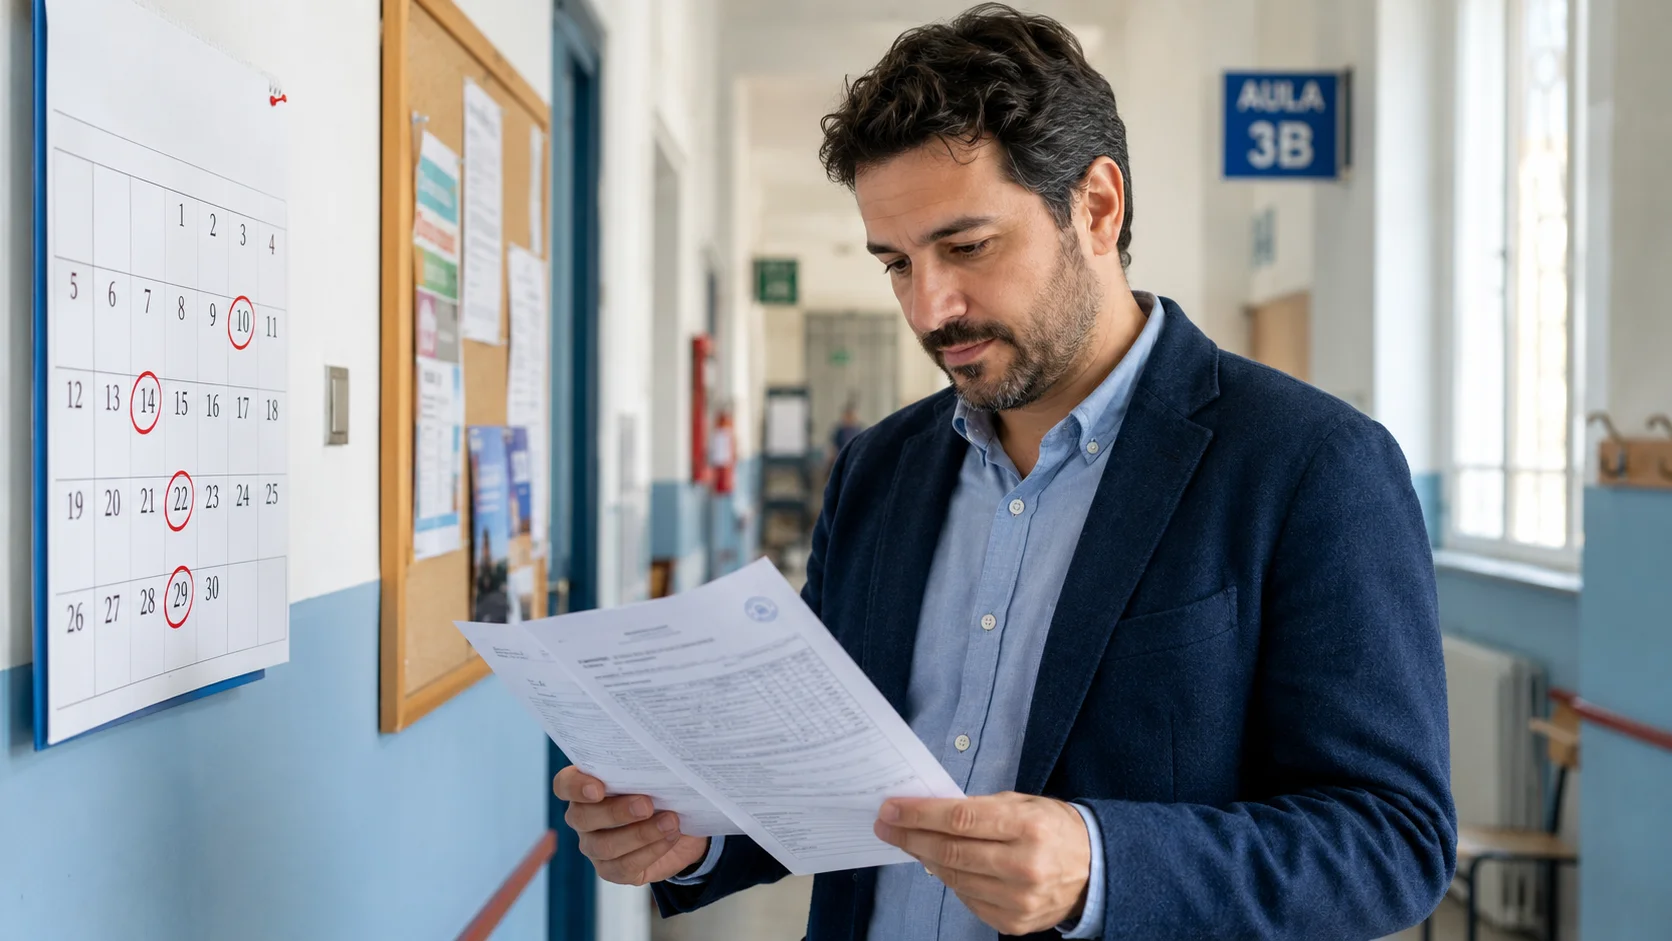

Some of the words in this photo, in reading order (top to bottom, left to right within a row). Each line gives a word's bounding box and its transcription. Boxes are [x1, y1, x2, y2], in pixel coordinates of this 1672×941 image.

[1238, 80, 1324, 112] AULA
[1248, 120, 1313, 169] 3B
[178, 203, 186, 228] 1
[209, 213, 217, 238] 2
[240, 223, 247, 247] 3
[268, 234, 275, 255] 4
[70, 271, 78, 300] 5
[108, 280, 117, 308] 6
[143, 288, 152, 314] 7
[177, 295, 185, 321] 8
[209, 302, 217, 327] 9
[236, 308, 250, 333] 10
[266, 315, 277, 338] 11
[67, 380, 83, 409] 12
[105, 384, 120, 412] 13
[140, 387, 156, 414] 14
[174, 390, 189, 416] 15
[206, 393, 220, 418] 16
[237, 396, 249, 420] 17
[266, 399, 279, 421] 18
[68, 490, 84, 520] 19
[105, 488, 121, 517] 20
[140, 487, 155, 514] 21
[173, 485, 188, 512] 22
[205, 484, 219, 509] 23
[235, 483, 250, 507] 24
[265, 482, 279, 505] 25
[67, 602, 84, 634] 26
[104, 594, 121, 625] 27
[140, 587, 156, 616] 28
[173, 580, 188, 609] 29
[205, 575, 220, 602] 30
